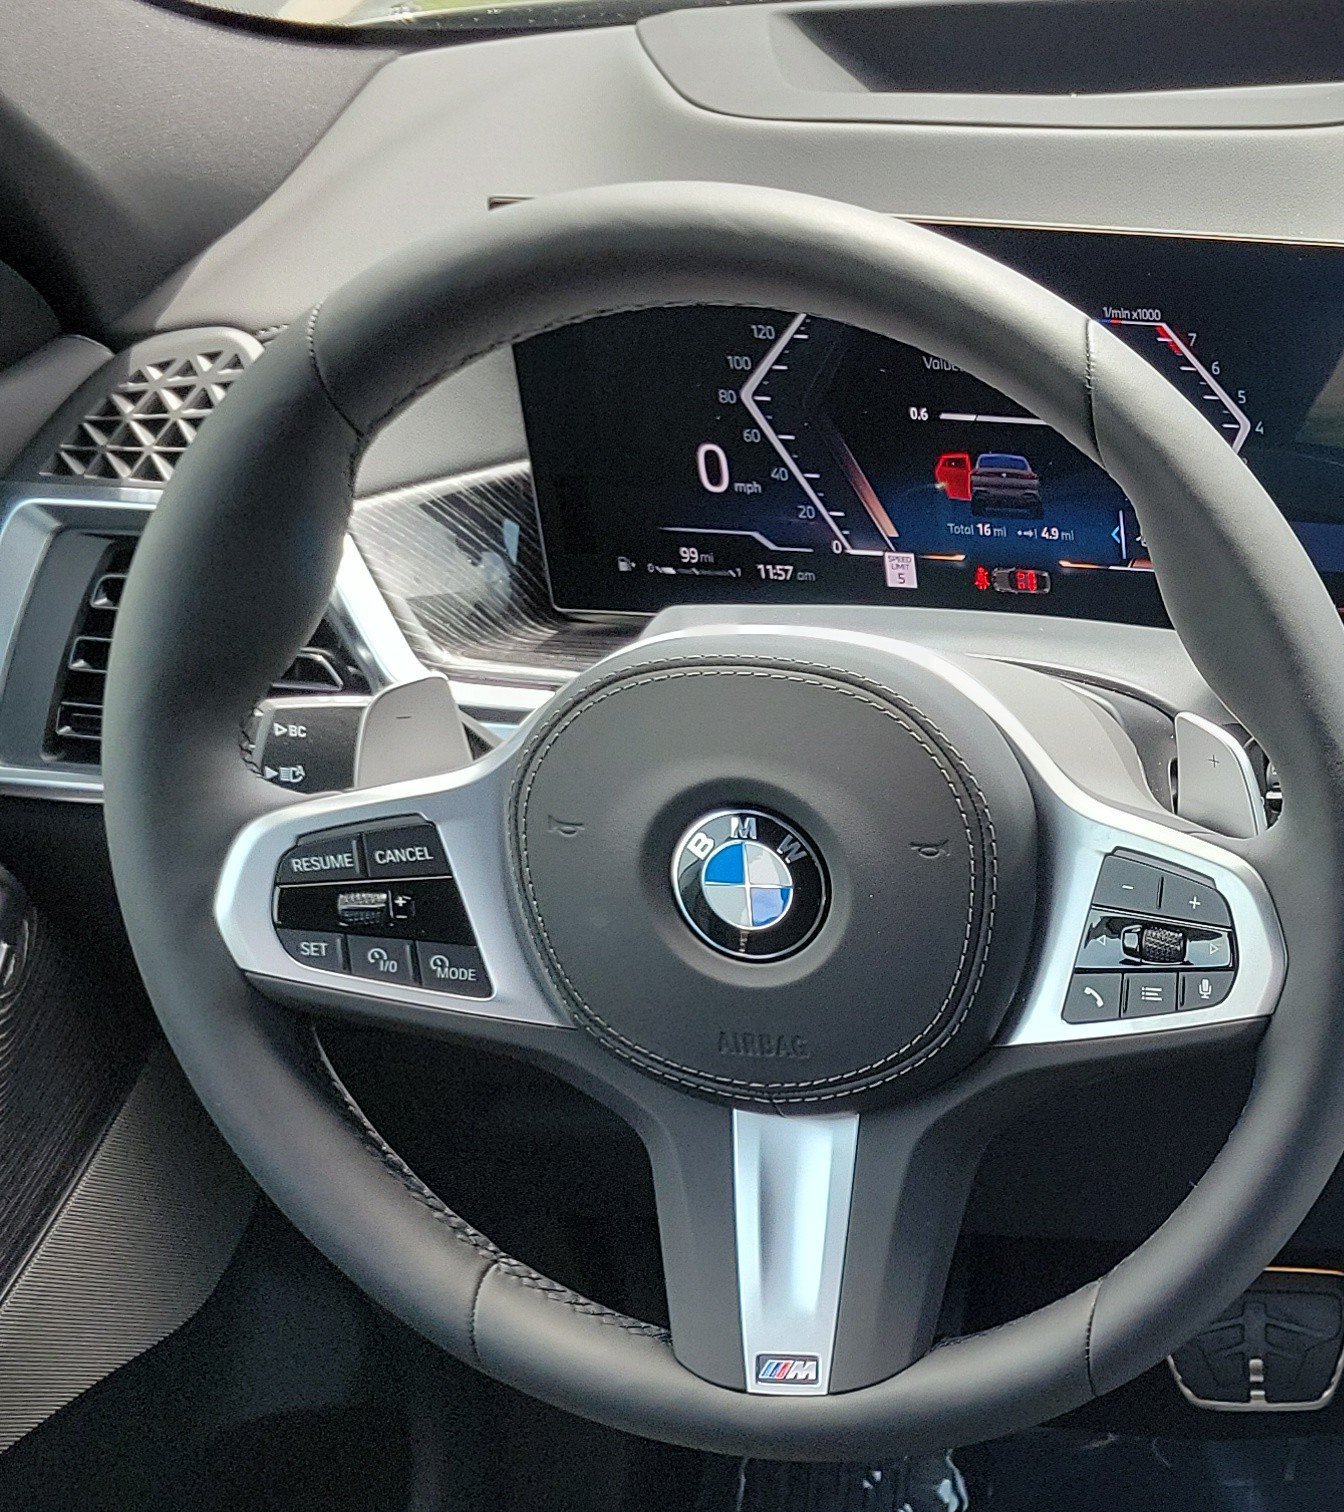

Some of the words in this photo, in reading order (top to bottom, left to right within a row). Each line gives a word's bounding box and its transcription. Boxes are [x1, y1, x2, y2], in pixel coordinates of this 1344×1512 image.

[1103, 307, 1131, 320] 1/min
[1132, 308, 1161, 321] x1000
[751, 325, 775, 340] 120
[1188, 334, 1197, 347] 7
[727, 355, 751, 371] 100
[1211, 361, 1220, 376] 6
[718, 390, 737, 405] 80
[1237, 390, 1247, 404] 5
[909, 407, 928, 420] 0.6
[743, 428, 761, 443] 60
[1255, 422, 1264, 435] 4
[696, 442, 730, 493] 0
[734, 480, 762, 496] mph
[771, 467, 789, 482] 40
[798, 505, 816, 520] 20
[947, 523, 974, 537] Total
[976, 523, 991, 537] 16
[993, 526, 1006, 538] mi
[1041, 527, 1059, 541] 4.9
[1061, 529, 1074, 541] mi
[679, 547, 699, 563] 99
[700, 550, 714, 563] mi
[831, 540, 842, 555] 0
[756, 564, 793, 581] 11:57
[797, 569, 816, 582] am
[898, 573, 906, 585] 5
[288, 725, 307, 738] BC
[375, 846, 433, 864] CANCEL
[292, 853, 354, 873] RESUME
[300, 942, 328, 957] SET
[436, 967, 477, 981] MODE
